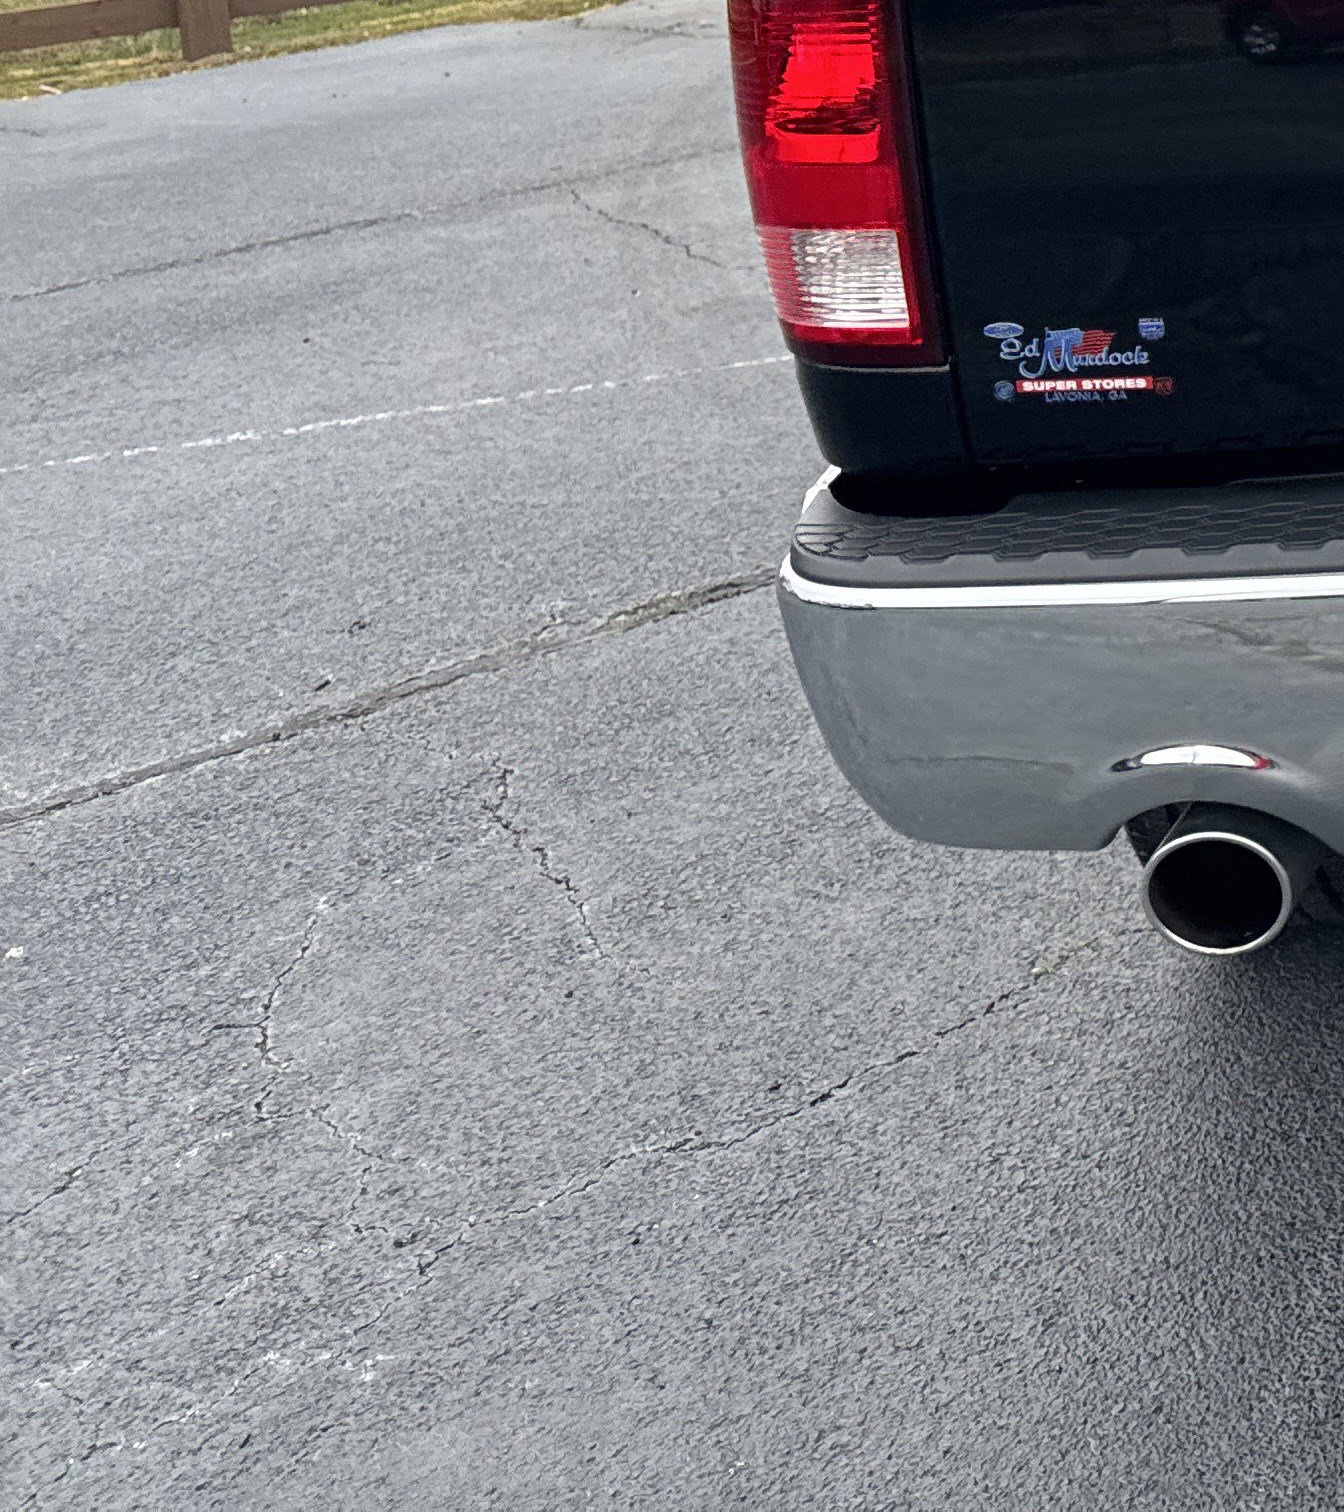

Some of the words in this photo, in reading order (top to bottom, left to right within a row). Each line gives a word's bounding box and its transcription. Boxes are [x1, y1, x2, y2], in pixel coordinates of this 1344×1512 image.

[1000, 338, 1041, 360] Ed
[1019, 334, 1150, 378] Murdock
[1022, 380, 1078, 391] SUPER
[1082, 377, 1147, 390] STORES
